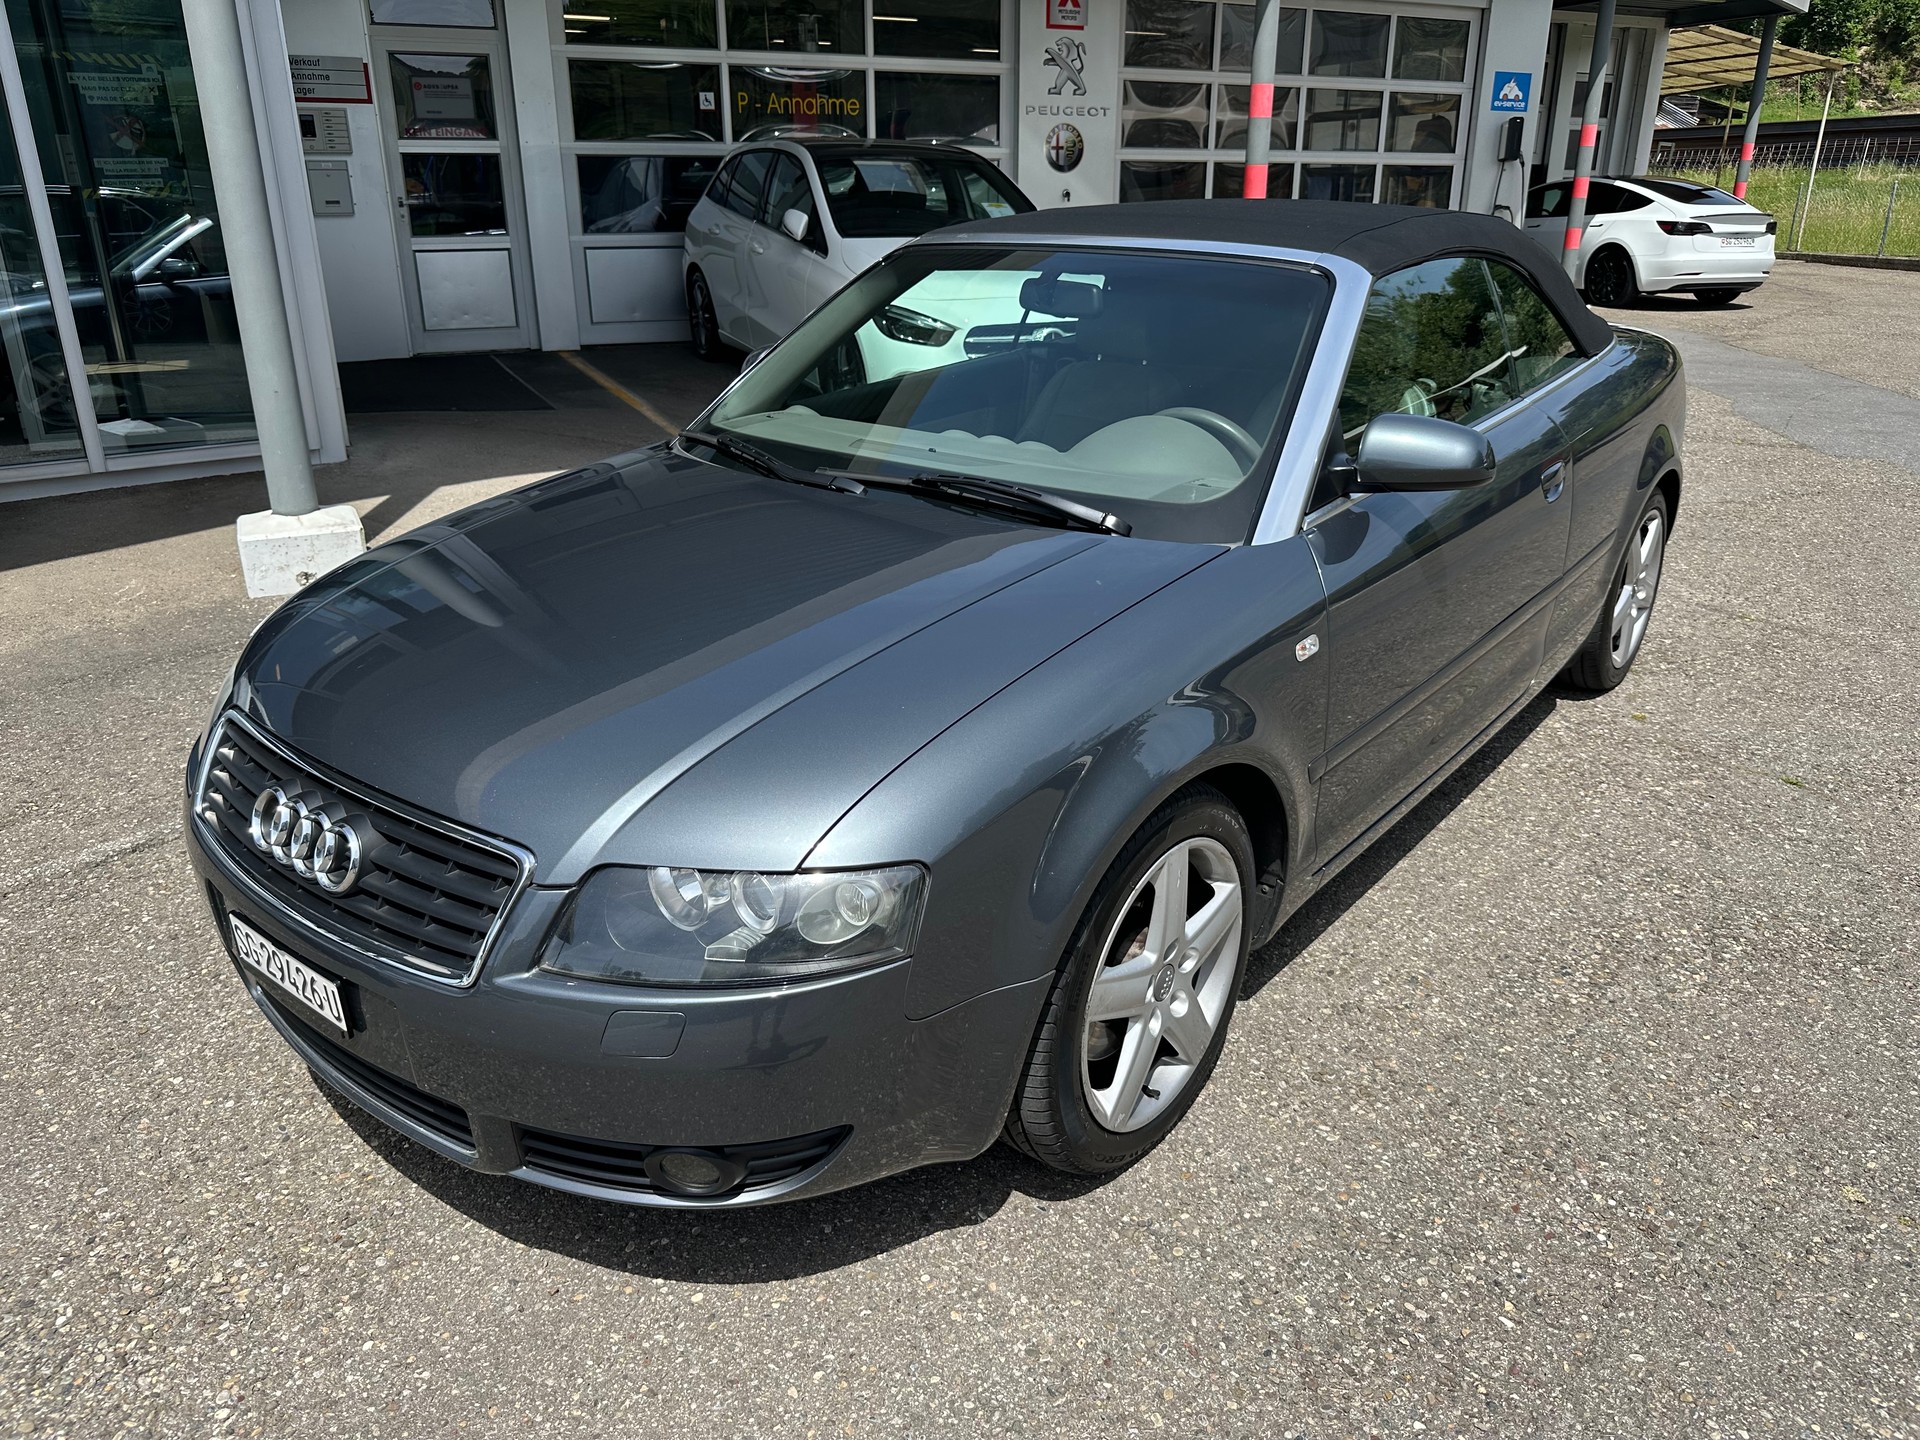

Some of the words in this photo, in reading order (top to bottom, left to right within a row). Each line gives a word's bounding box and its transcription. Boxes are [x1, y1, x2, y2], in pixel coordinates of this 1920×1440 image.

[289, 58, 321, 67] Verkauf
[291, 72, 331, 81] Annahme
[737, 92, 749, 114] P
[767, 92, 860, 116] Annahme
[1025, 105, 1111, 117] PEUGEOT
